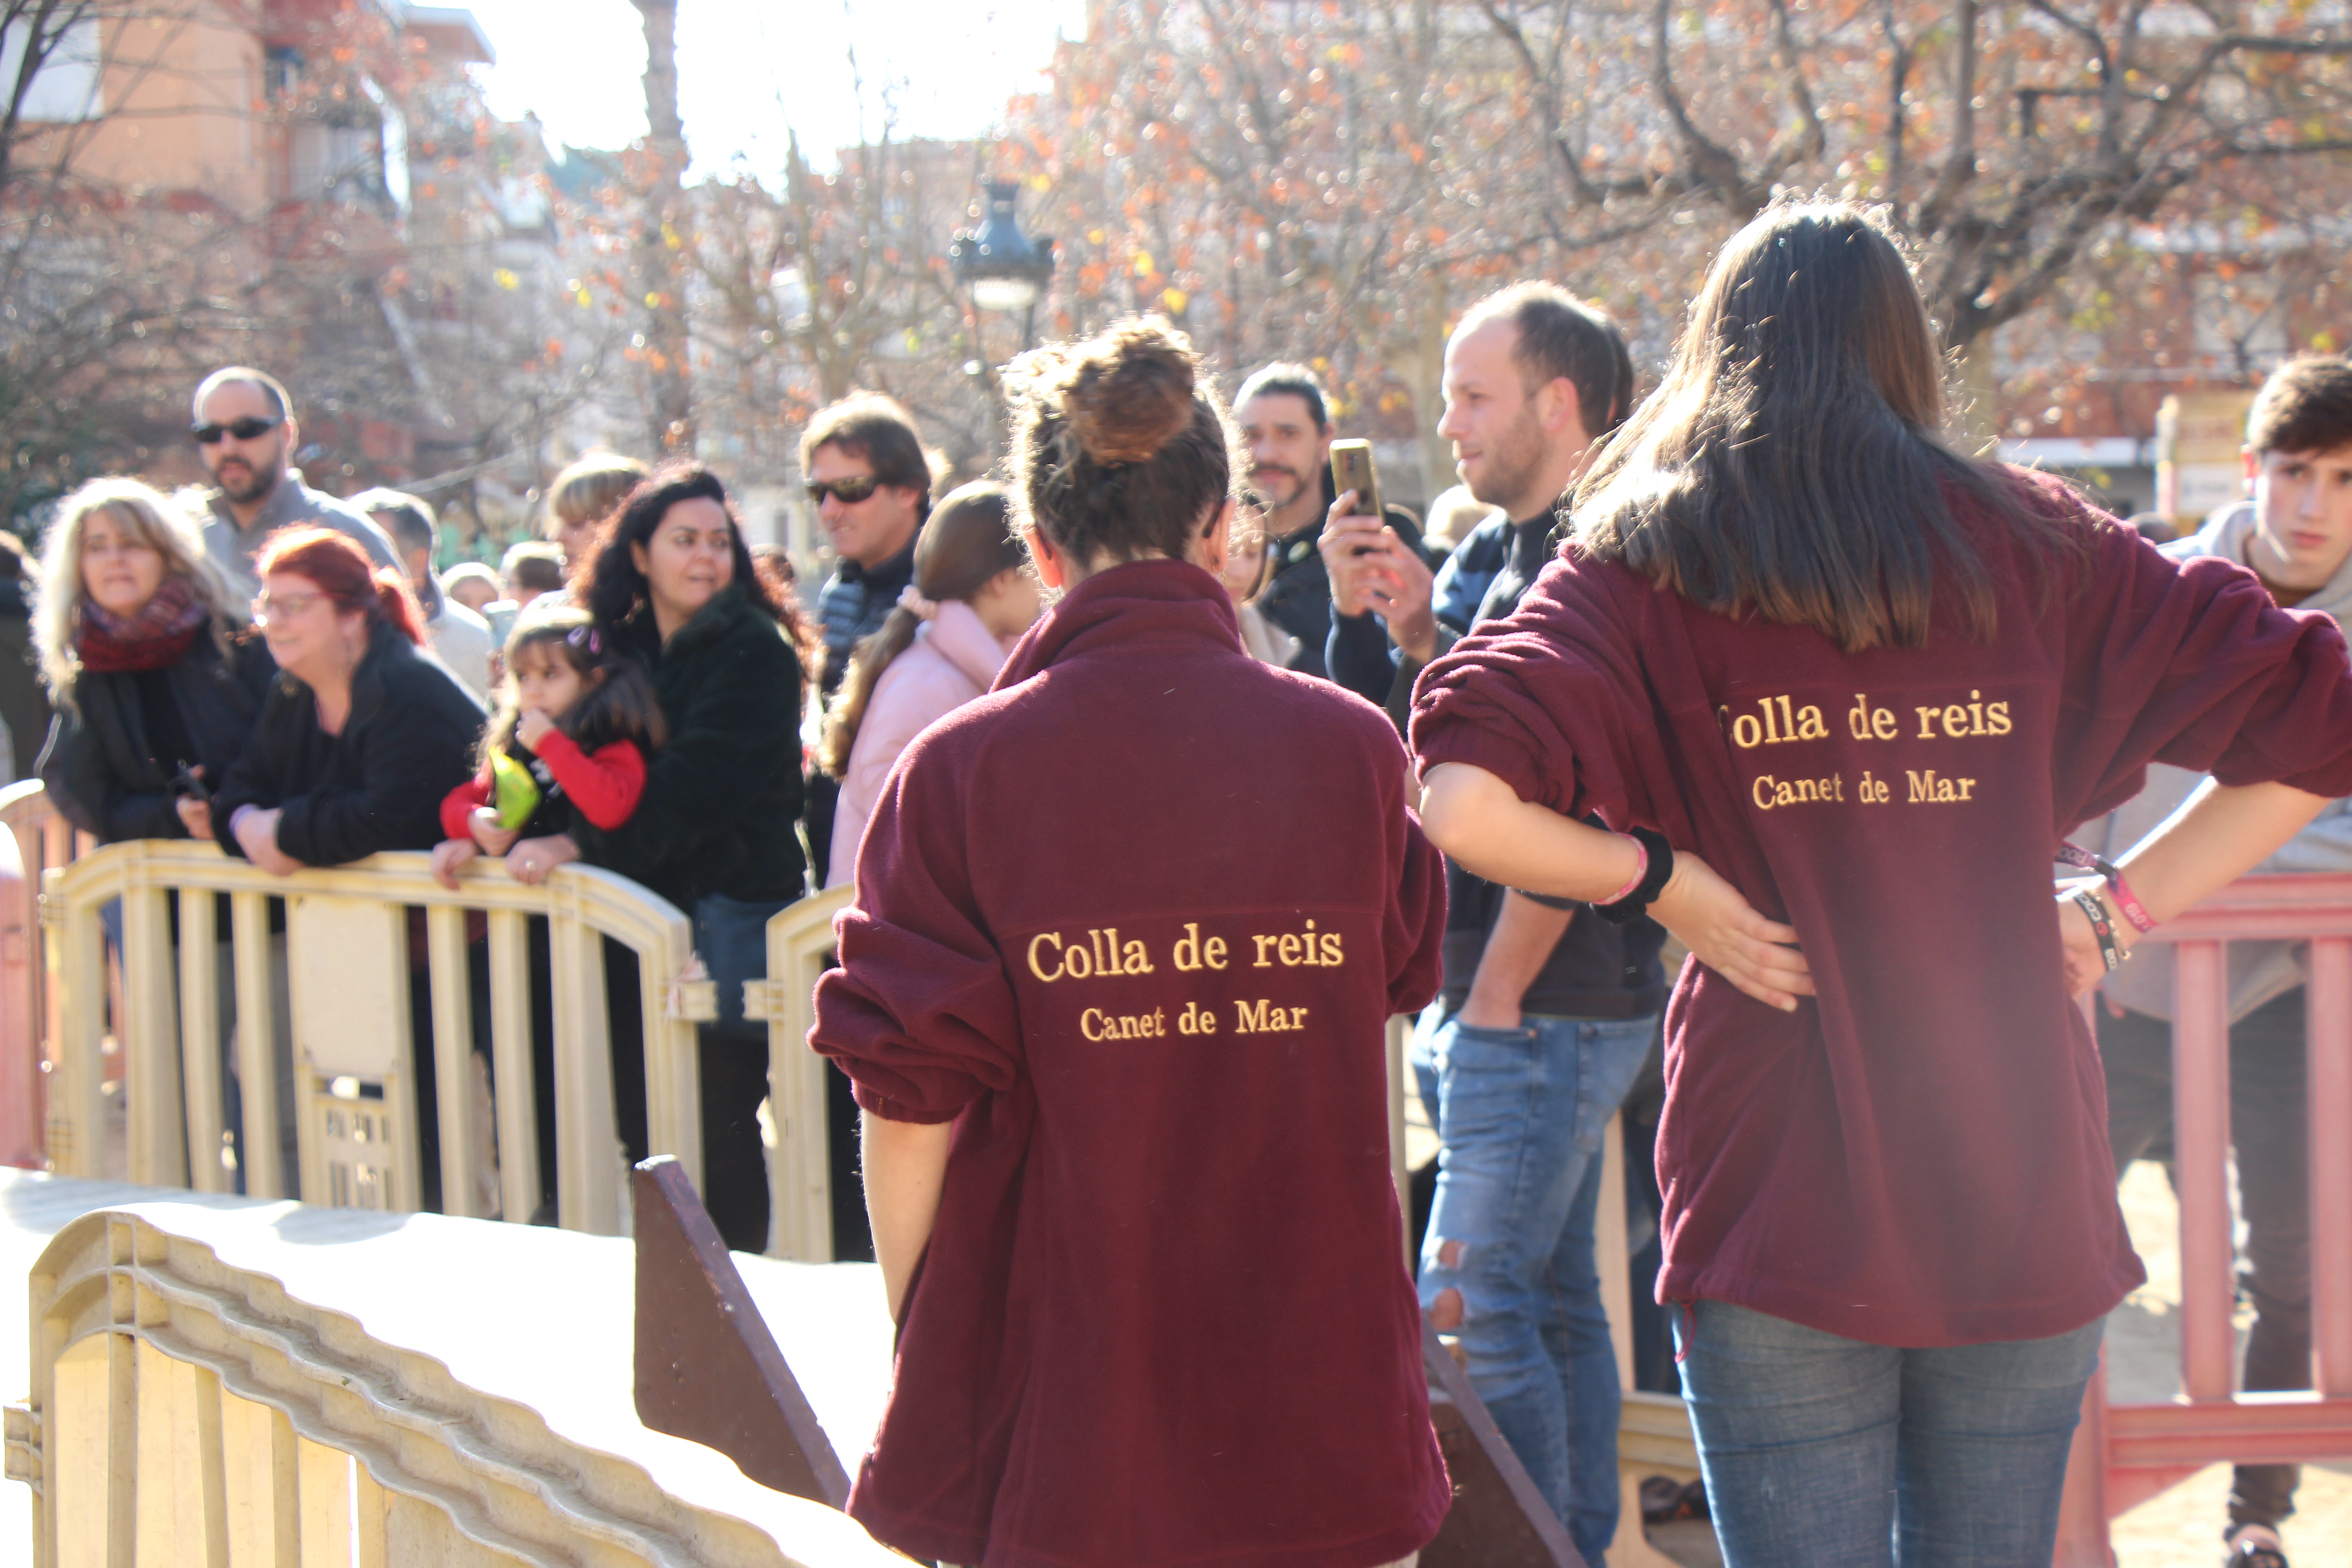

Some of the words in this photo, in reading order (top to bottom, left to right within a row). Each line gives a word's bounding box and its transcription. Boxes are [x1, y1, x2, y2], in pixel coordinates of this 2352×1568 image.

[1848, 693, 1898, 740] de
[1915, 689, 2012, 739] reis
[1752, 773, 1844, 810] Canet
[1859, 770, 1890, 804] de
[1905, 769, 1976, 804] Mar
[1027, 928, 1154, 982] Colla
[1173, 922, 1228, 971] de
[1251, 919, 1344, 967] reis
[1080, 1007, 1165, 1042] Canet
[1178, 1001, 1216, 1035] de
[1234, 999, 1308, 1034] Mar
